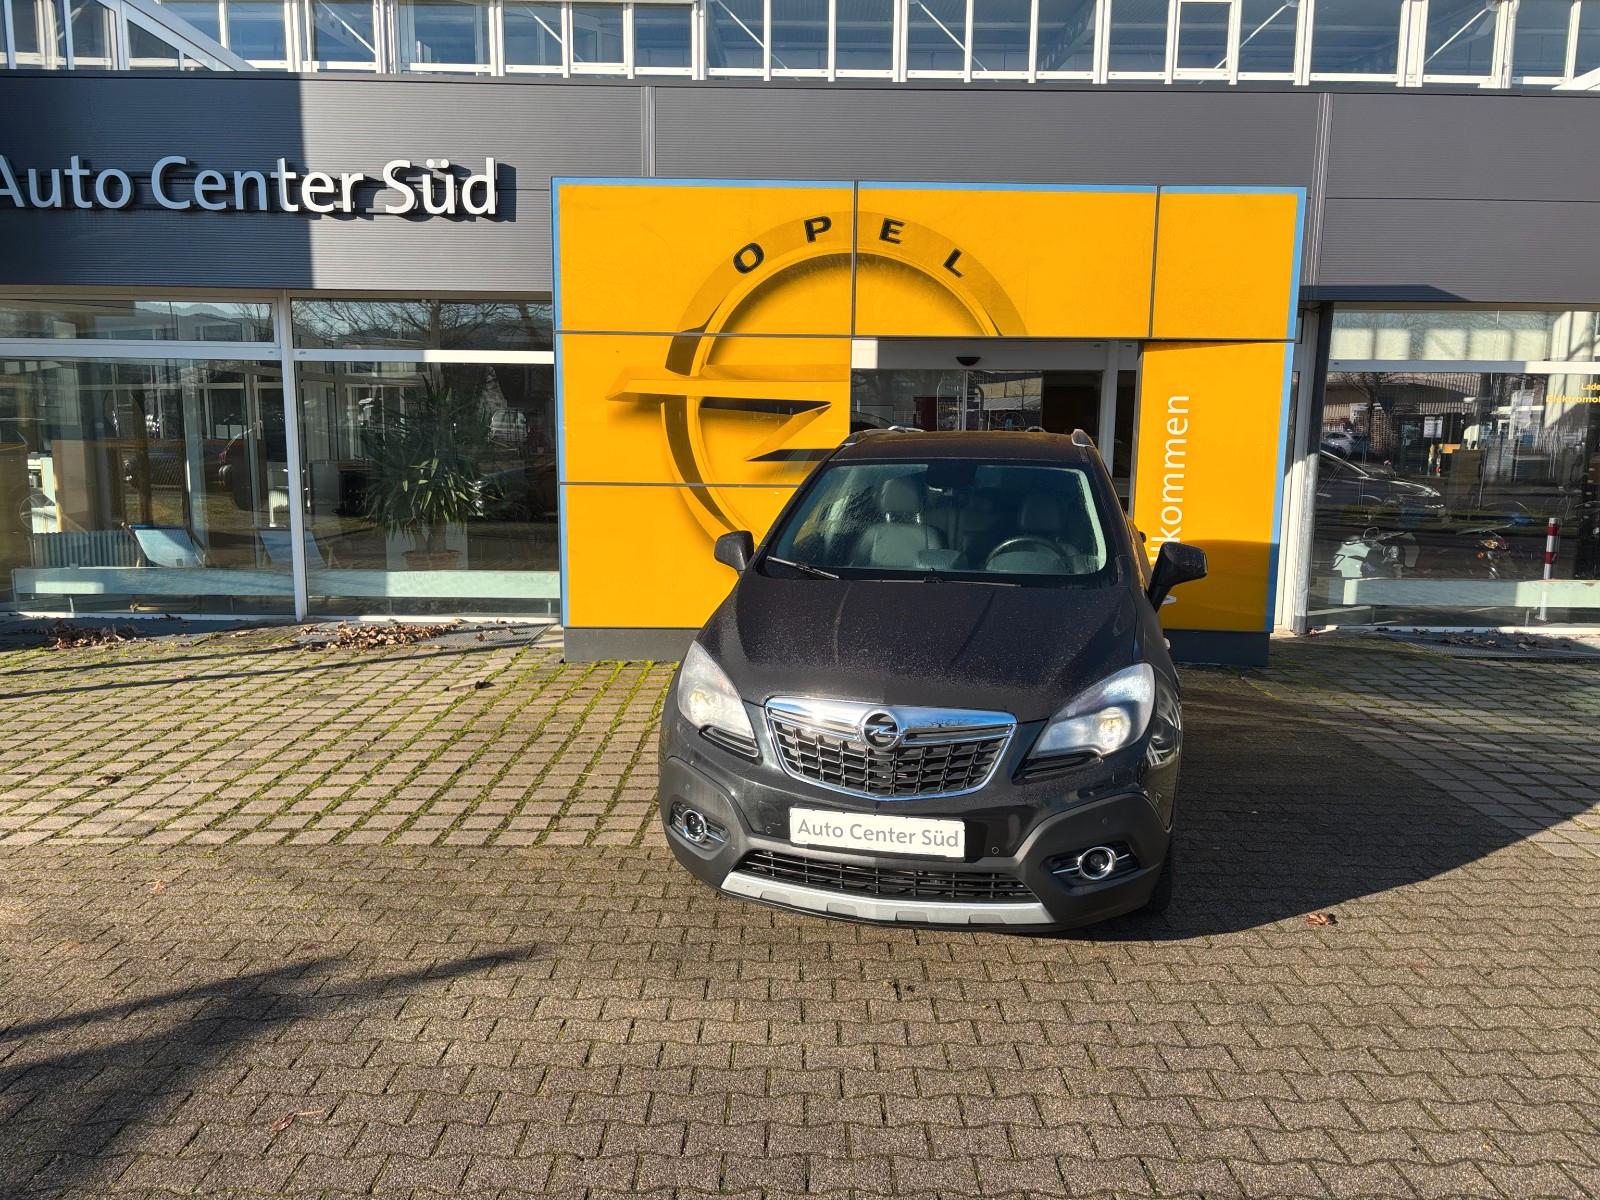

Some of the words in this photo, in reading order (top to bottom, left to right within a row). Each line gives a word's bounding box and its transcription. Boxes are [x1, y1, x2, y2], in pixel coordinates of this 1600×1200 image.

[151, 155, 364, 213] Center
[382, 157, 497, 215] Süd
[732, 215, 965, 278] OPEL
[1149, 395, 1190, 561] kommen
[797, 818, 844, 838] Auto
[849, 823, 917, 845] Center
[921, 829, 960, 848] Süd
